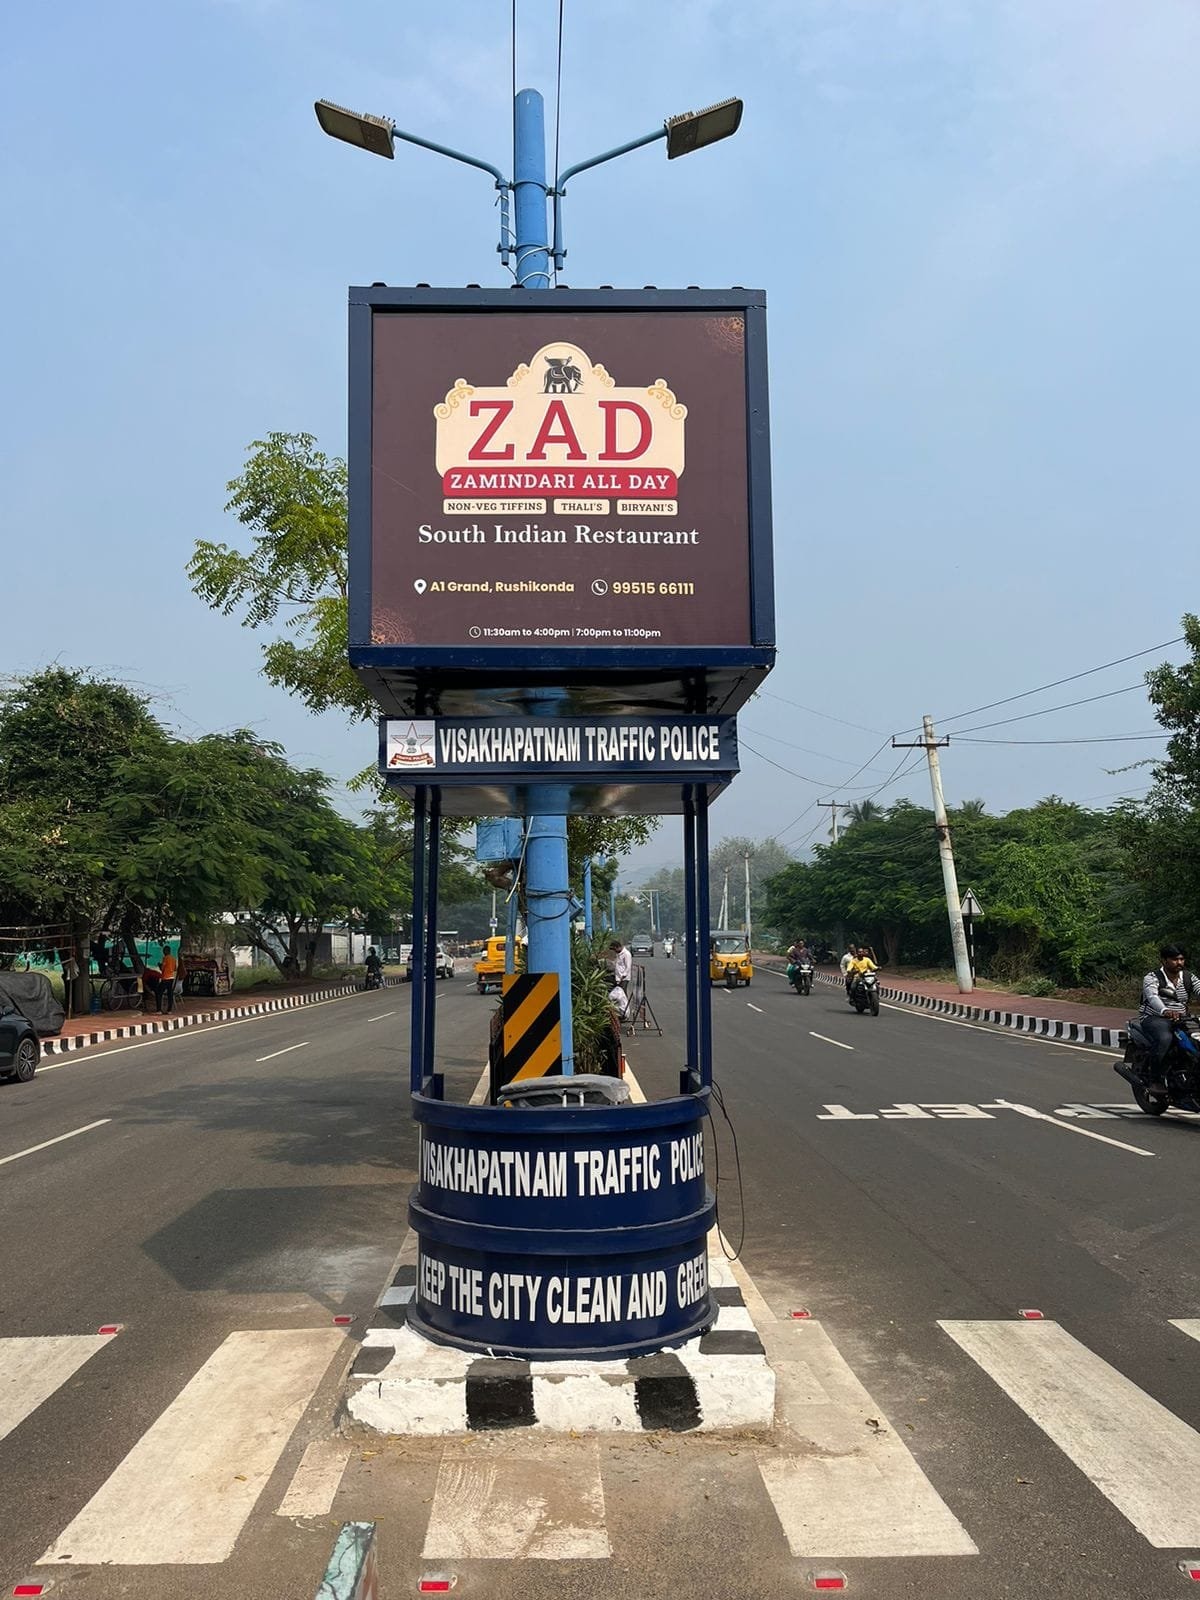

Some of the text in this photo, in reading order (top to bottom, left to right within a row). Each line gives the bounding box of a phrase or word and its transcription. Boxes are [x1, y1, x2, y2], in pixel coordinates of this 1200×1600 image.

[468, 400, 652, 461] ZAD
[450, 474, 670, 491] ZAMINDARI ALL DAY
[447, 502, 543, 512] NON-VEG TIFFINS
[561, 502, 603, 512] THALI'S
[621, 503, 674, 513] BIRYANI'S
[418, 524, 700, 545] South Indian Restaurant
[430, 581, 575, 594] A1 Grand, Rushikonda
[612, 582, 695, 595] 99515 66111
[483, 627, 661, 639] 11:30am to 4:00pm 7:00pm to 11:00pm
[440, 725, 720, 763] VISAKHAPATNAM TRAFFIC POLICE
[423, 1138, 568, 1197] VISAKHAPATNAM
[574, 1143, 661, 1197] TRAFFIC
[421, 1251, 708, 1324] KEEP THE CITY CLEAN AND GREE
